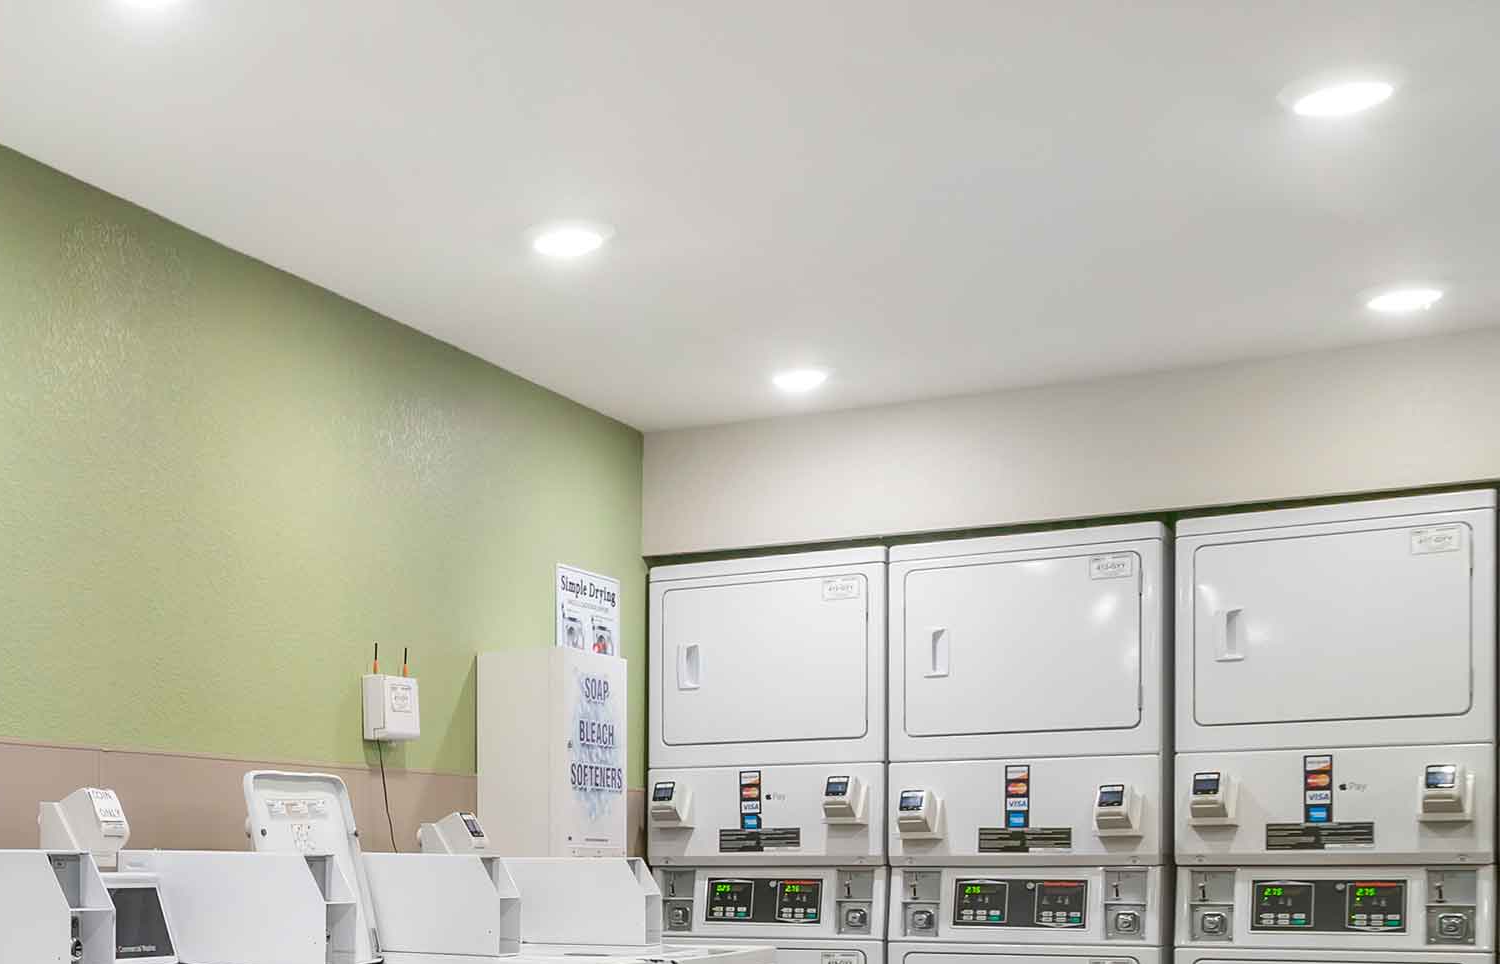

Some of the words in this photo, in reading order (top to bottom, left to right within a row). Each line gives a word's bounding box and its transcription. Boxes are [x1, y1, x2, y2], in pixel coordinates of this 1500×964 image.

[561, 575, 587, 599] Simple
[589, 582, 616, 608] Drying
[585, 678, 609, 701] SOAP
[579, 720, 614, 745] BLEACH
[571, 762, 622, 789] SOFTENERS
[1308, 793, 1330, 801] VISA
